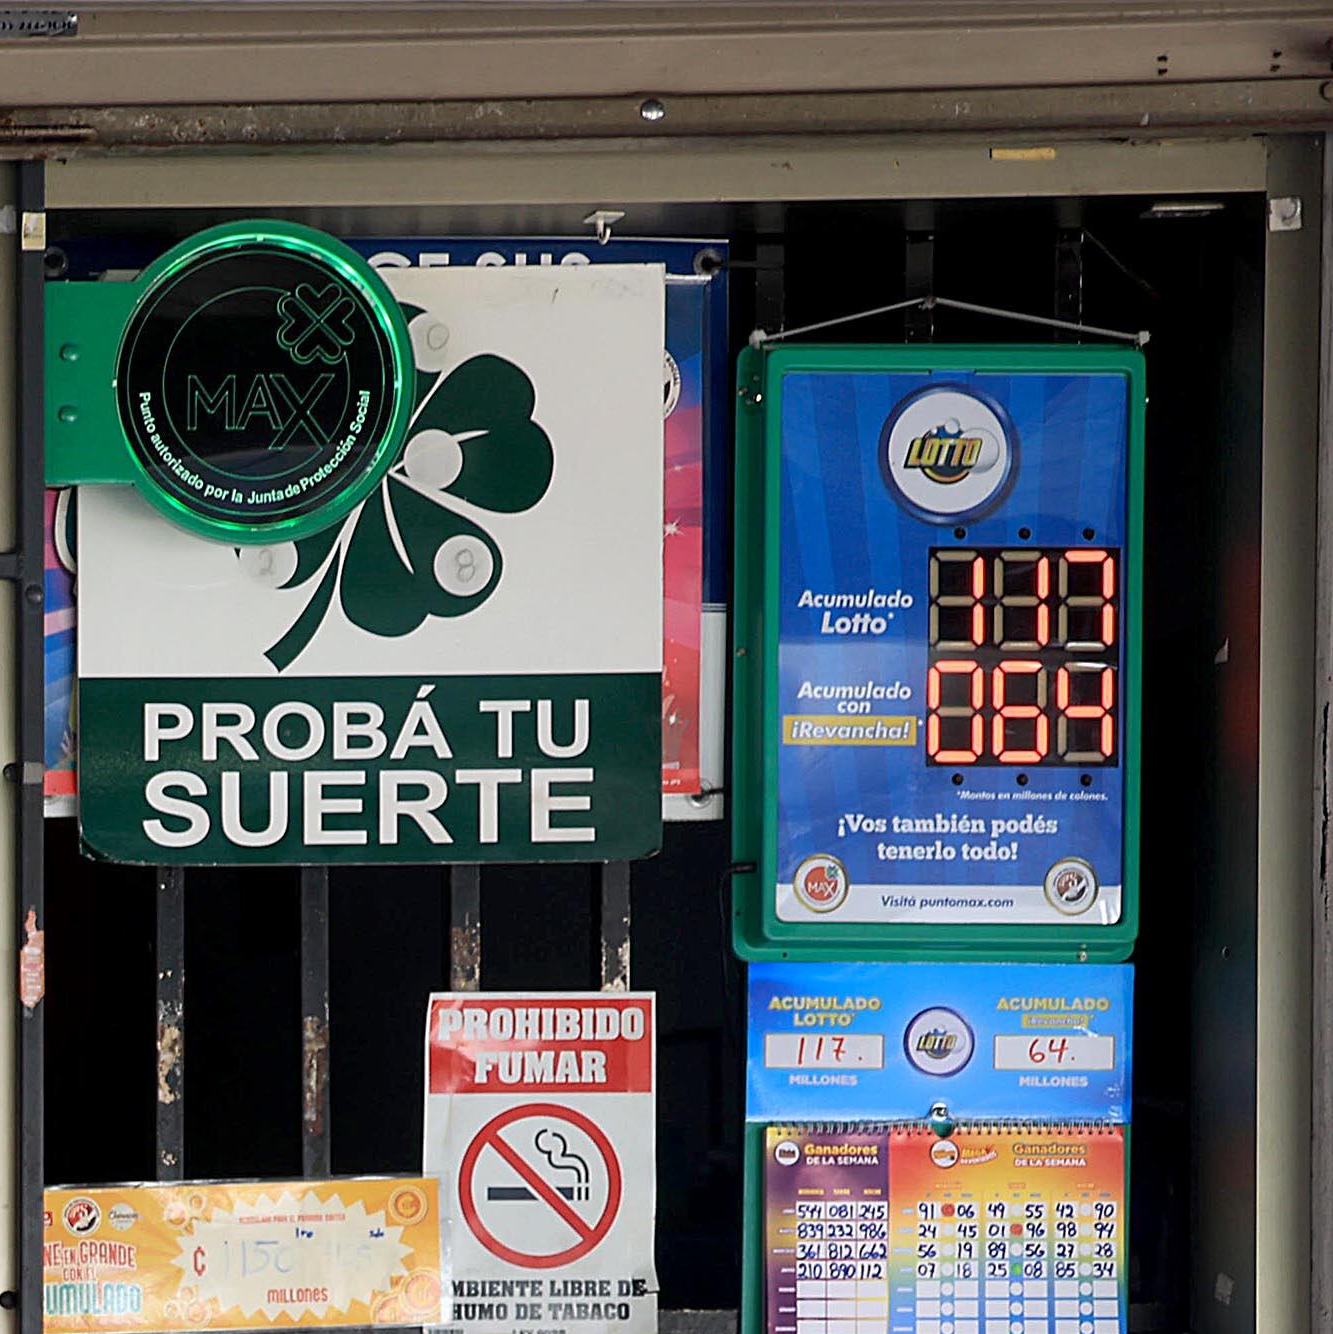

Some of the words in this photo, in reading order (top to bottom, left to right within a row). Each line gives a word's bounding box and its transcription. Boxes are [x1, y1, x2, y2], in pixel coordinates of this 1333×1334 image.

[187, 373, 335, 451] MAX
[139, 391, 156, 434] Punto
[151, 431, 204, 491] autorizado
[203, 484, 229, 502] por
[231, 487, 243, 504] la
[247, 490, 284, 505] Junta
[284, 483, 301, 500] de
[300, 435, 357, 492] Protección
[349, 390, 371, 435] Social
[798, 590, 914, 609] Acumulado
[797, 682, 912, 700] Acumulado
[837, 700, 872, 714] con
[928, 660, 1114, 764] 064
[143, 684, 453, 762] PROBÁ
[479, 698, 592, 760] TU
[1012, 790, 1052, 800] millones
[1054, 791, 1067, 800] de
[141, 767, 597, 847] SUERTE
[837, 814, 889, 837] ¡Vos
[892, 813, 986, 835] también
[991, 812, 1058, 839] podés
[877, 841, 956, 862] tenerlo
[960, 840, 1019, 861] todo!
[881, 894, 915, 909] Visitá
[919, 896, 1014, 912] puntomax.com
[768, 997, 881, 1011] ACUMULADO
[997, 997, 1110, 1011] ACUMULADO
[437, 1005, 645, 1043] PROHIBIDO
[474, 1049, 607, 1086] FUMAR
[789, 1074, 858, 1086] MILLONES
[804, 1143, 878, 1156] Ganadores
[806, 1156, 820, 1166] DE
[822, 1156, 835, 1166] LA
[837, 1156, 879, 1167] SEMANA
[797, 1222, 824, 1239] 839
[828, 1224, 854, 1238] 232
[859, 1223, 886, 1239] 986
[79, 1243, 137, 1269] GRANDE
[451, 1279, 543, 1298] MBIENTE
[549, 1279, 614, 1298] LIBRE
[617, 1278, 646, 1298] DE
[452, 1303, 509, 1321] HUMO
[515, 1303, 543, 1321] DE
[548, 1302, 631, 1321] TABACO
